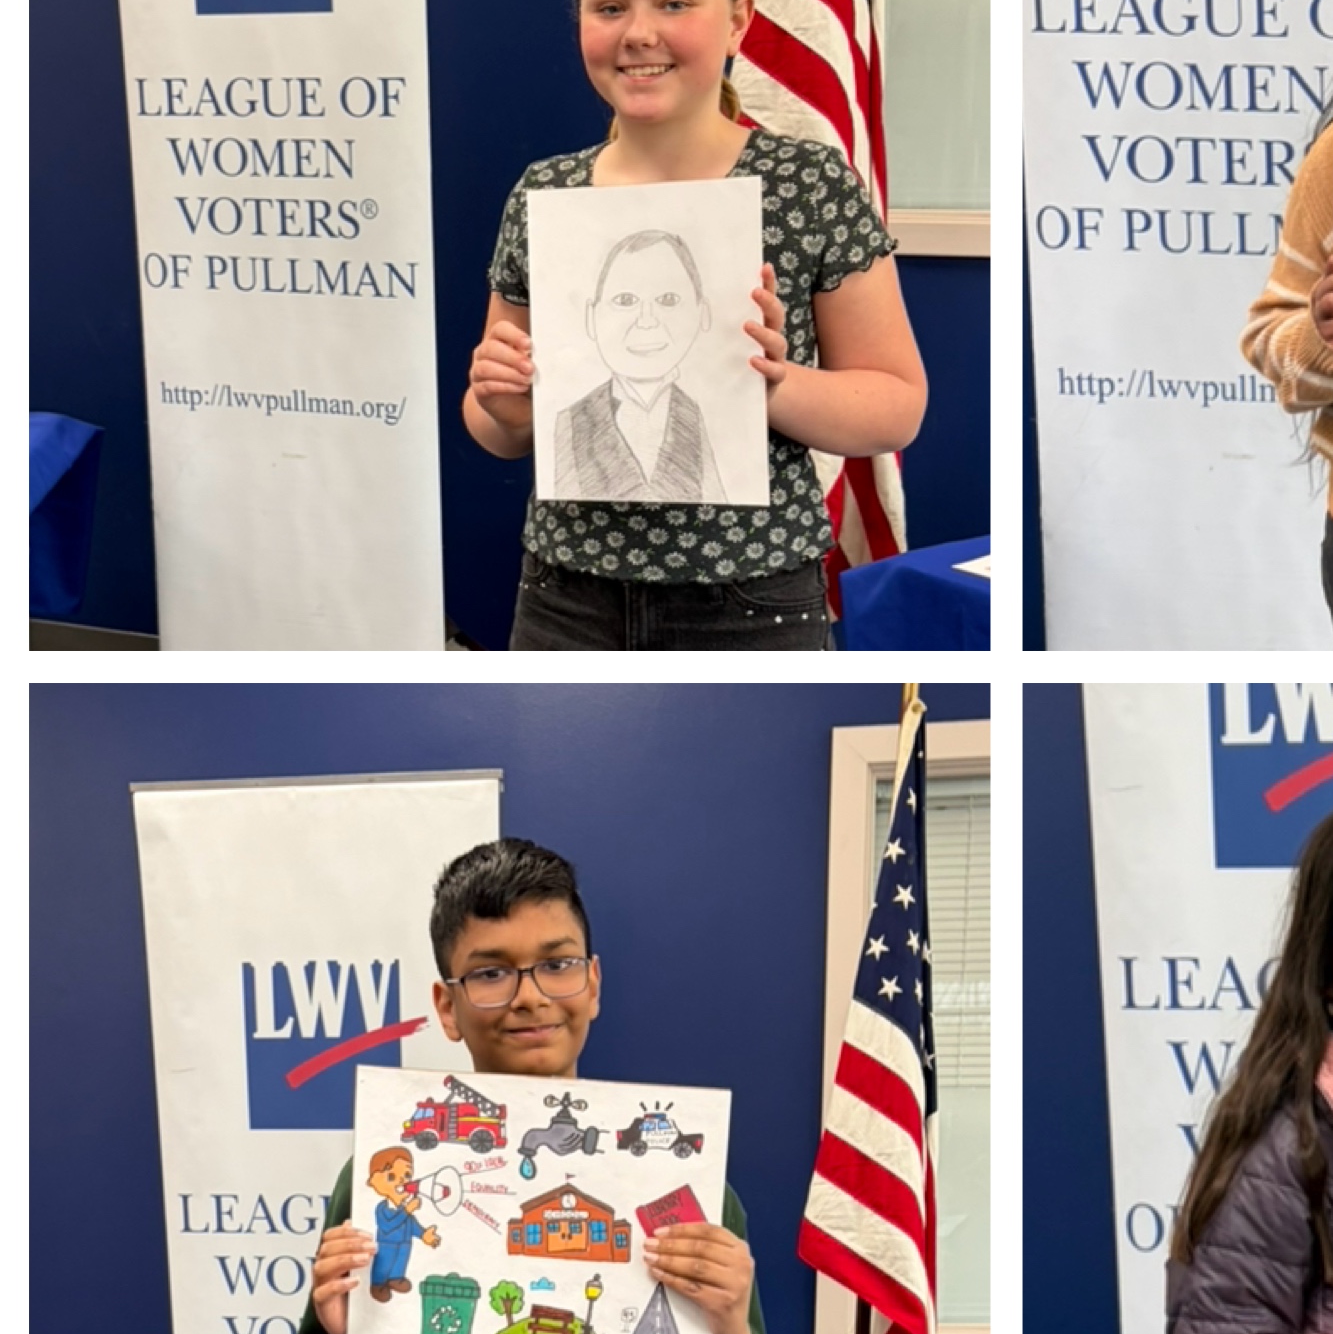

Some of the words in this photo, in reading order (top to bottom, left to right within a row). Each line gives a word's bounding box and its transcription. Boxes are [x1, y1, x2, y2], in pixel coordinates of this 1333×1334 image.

[135, 77, 325, 117] LEAGUE
[340, 77, 406, 118] OF
[1072, 60, 1328, 114] WOMEN
[166, 138, 355, 178] WOMEN
[1082, 135, 1308, 186] VOTER
[1036, 206, 1104, 250] OF
[1122, 208, 1284, 256] PULL
[144, 253, 192, 289] OF
[204, 255, 418, 298] PULLMAN
[161, 382, 407, 425] http://lwvpullman.org/
[253, 958, 400, 1040] LWV
[1118, 955, 1278, 1011] LEA
[178, 1193, 331, 1235] LEAG
